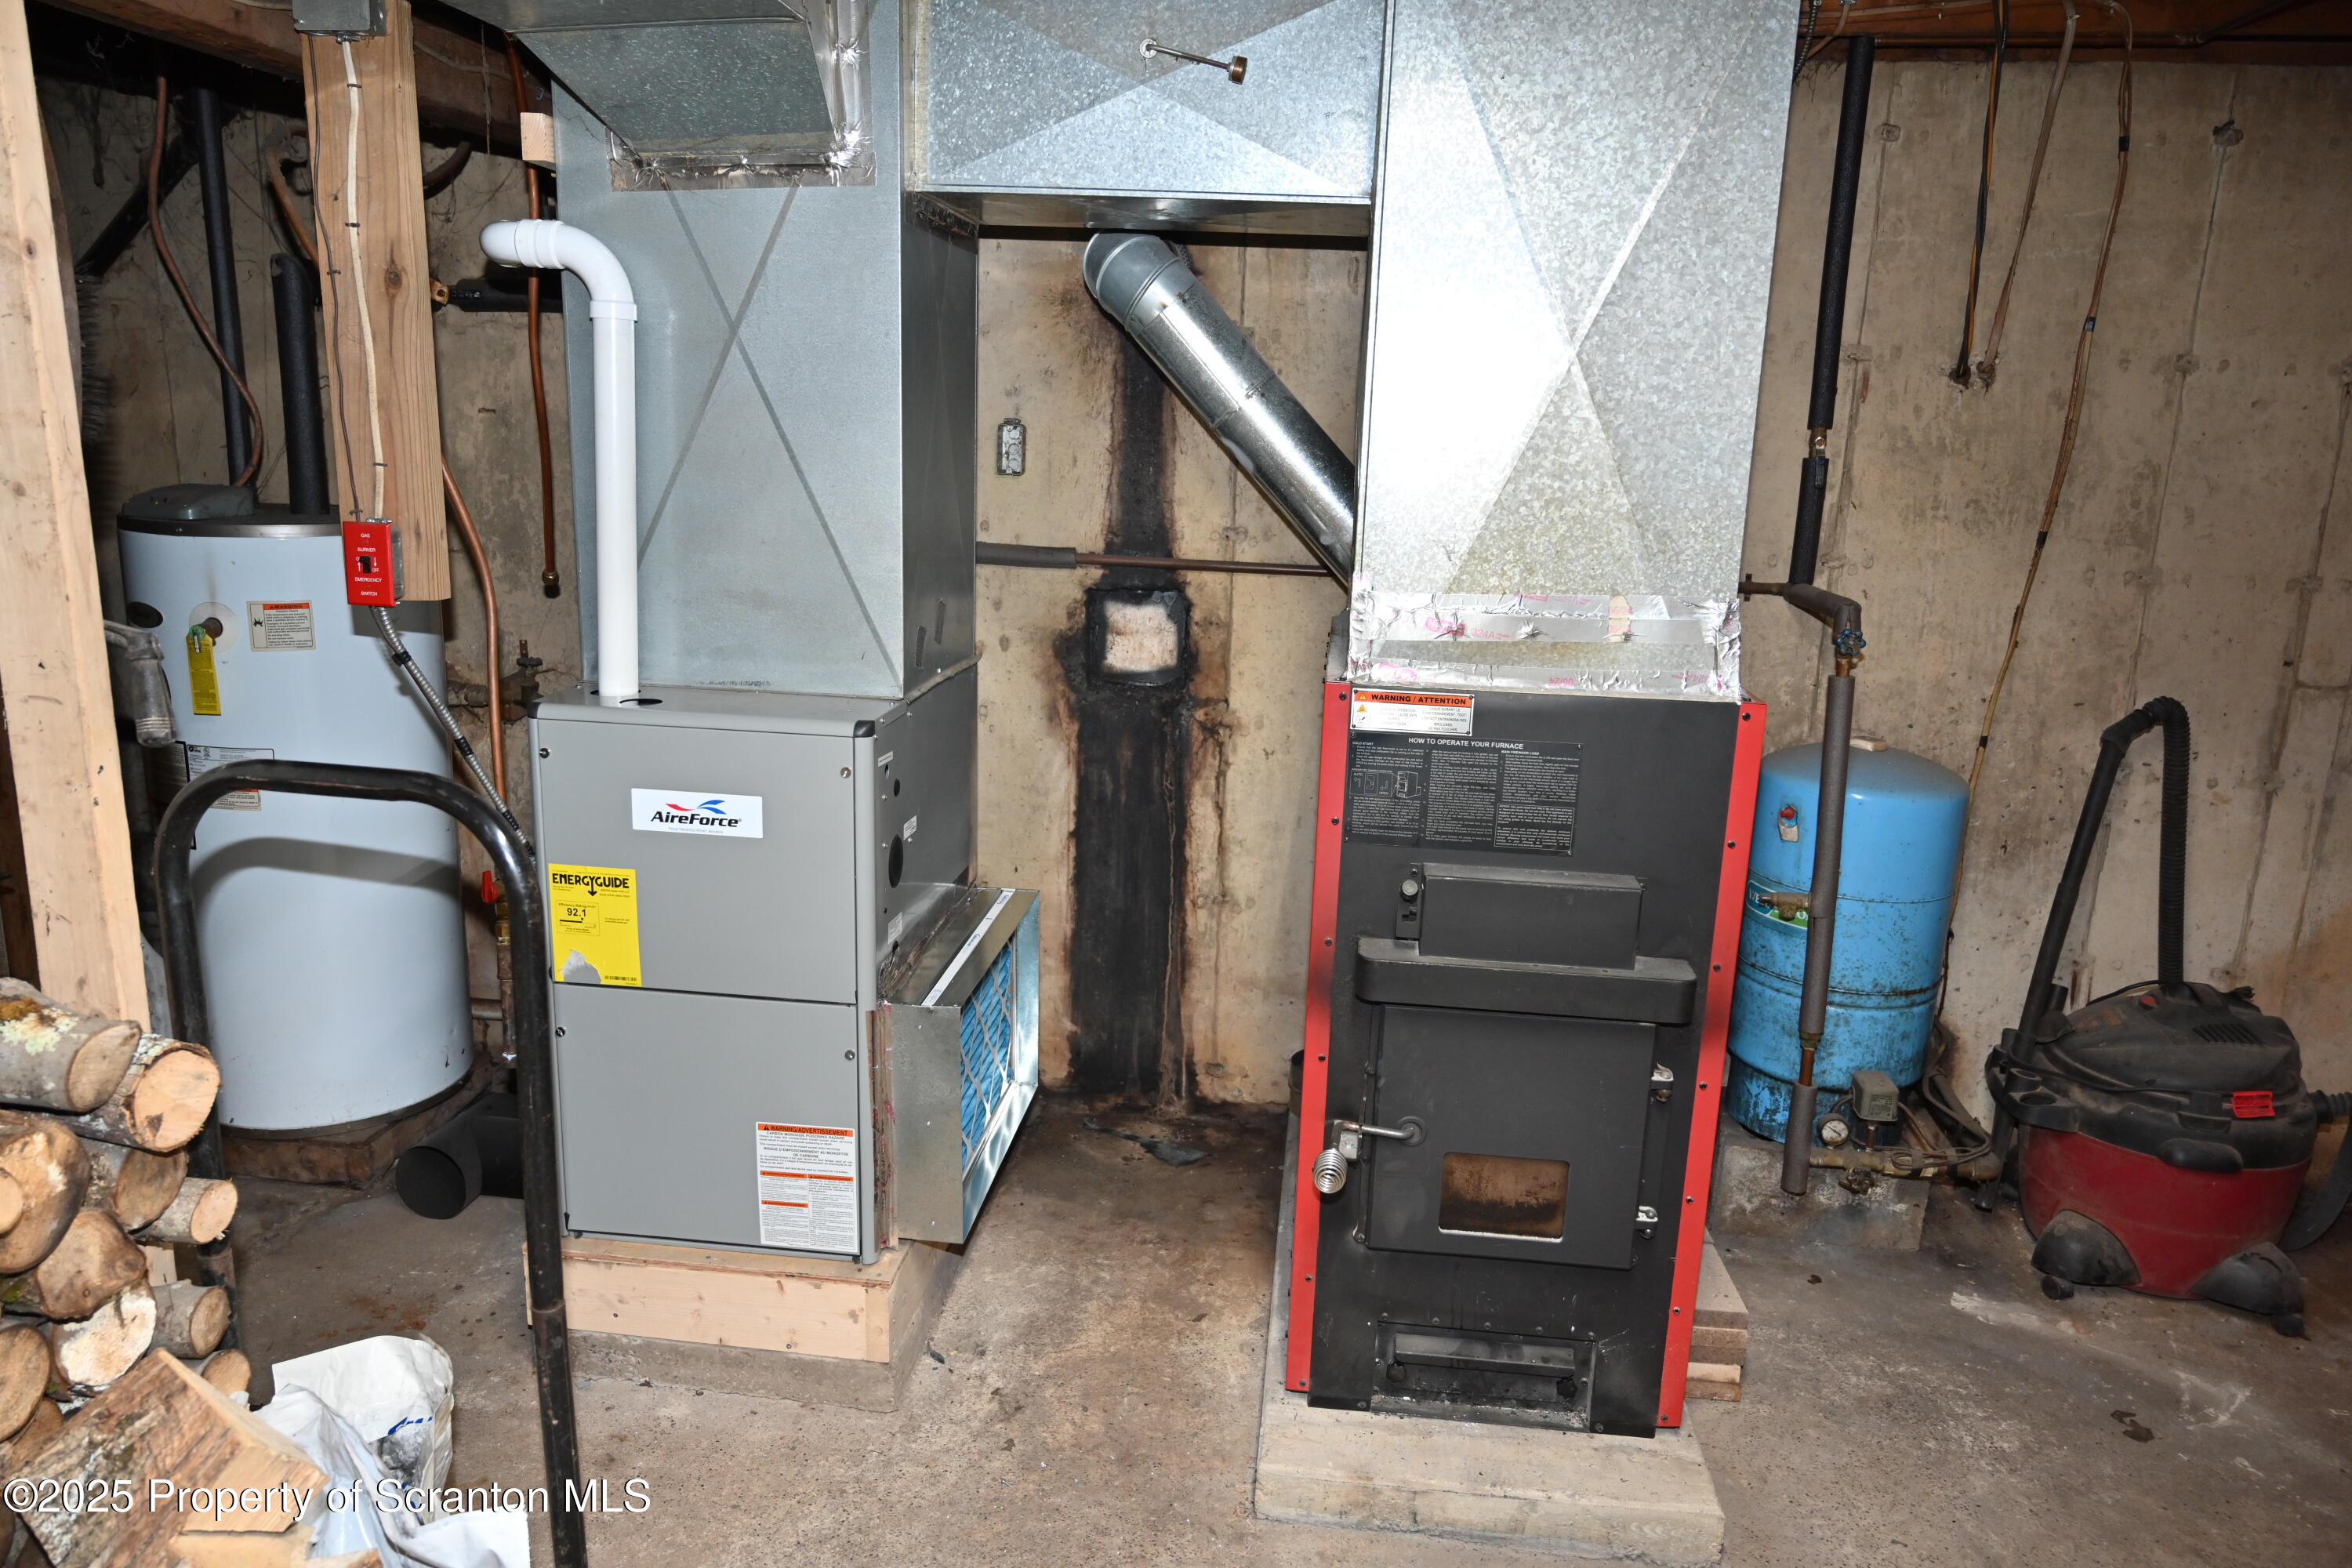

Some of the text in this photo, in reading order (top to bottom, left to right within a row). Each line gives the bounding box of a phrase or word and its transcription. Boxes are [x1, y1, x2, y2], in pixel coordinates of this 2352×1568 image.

[1472, 628, 1496, 639] 324A
[1371, 694, 1411, 702] WARNING
[651, 811, 739, 828] AireForce
[552, 873, 630, 895] ENERGYGUIDE
[567, 908, 586, 916] 92.1
[770, 1125, 848, 1136] WARNING/ADVERTISSEMENT
